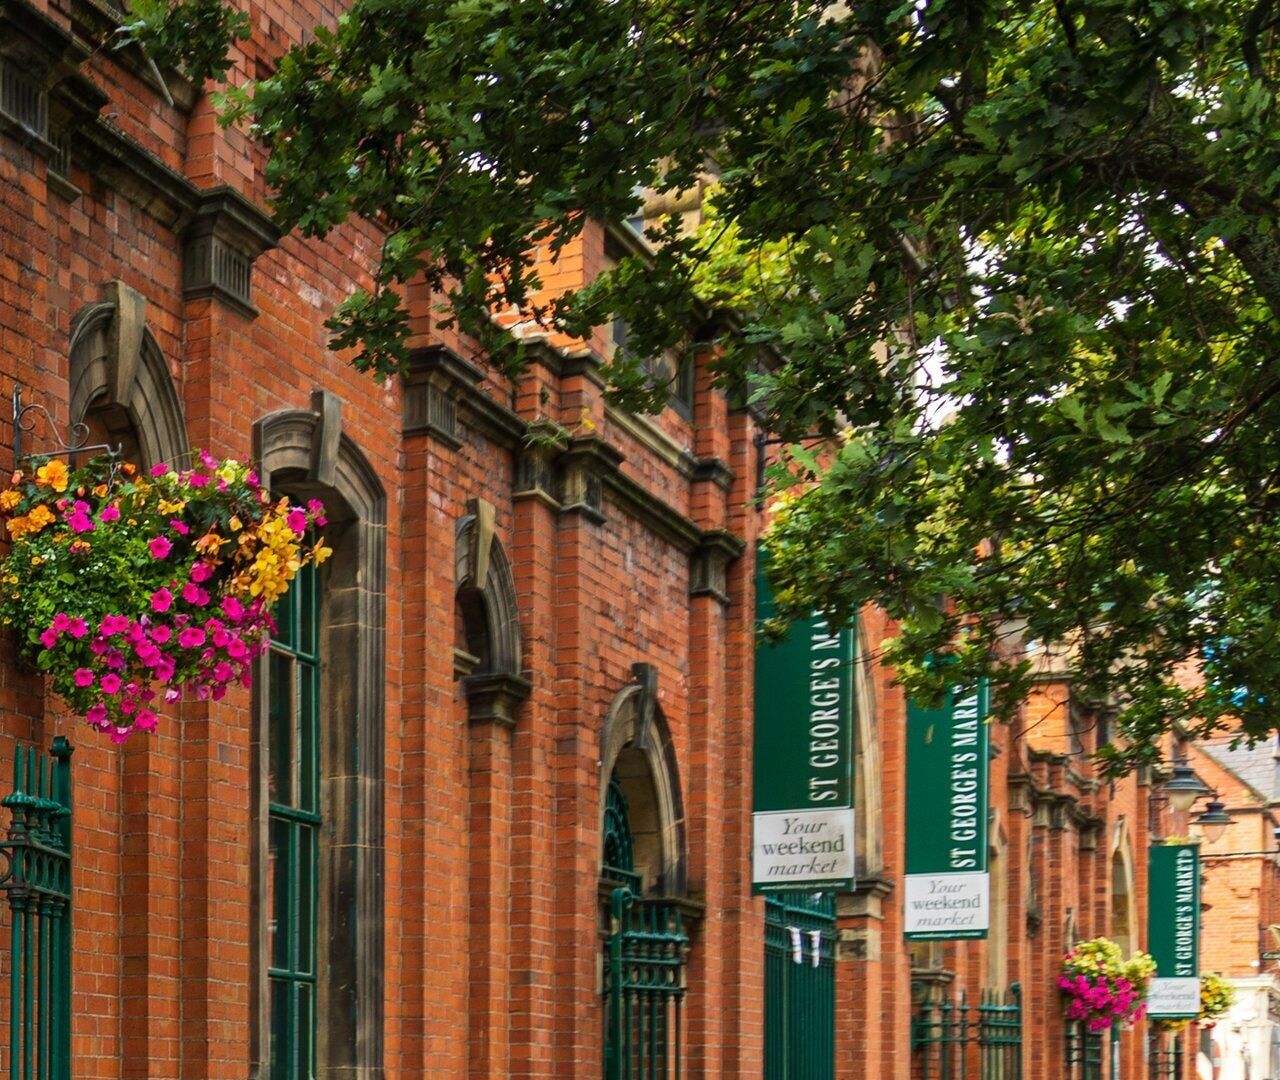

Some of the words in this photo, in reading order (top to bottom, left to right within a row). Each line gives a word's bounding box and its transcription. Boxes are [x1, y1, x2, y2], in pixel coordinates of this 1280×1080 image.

[809, 656, 840, 768] GEORGE'S
[808, 778, 838, 802] ST
[951, 752, 978, 842] GEORGE'S
[781, 817, 827, 836] Your
[761, 835, 845, 856] weekend
[768, 857, 839, 877] market
[951, 849, 975, 869] ST
[927, 879, 967, 895] Your
[912, 894, 981, 911] weekend
[917, 910, 975, 927] market
